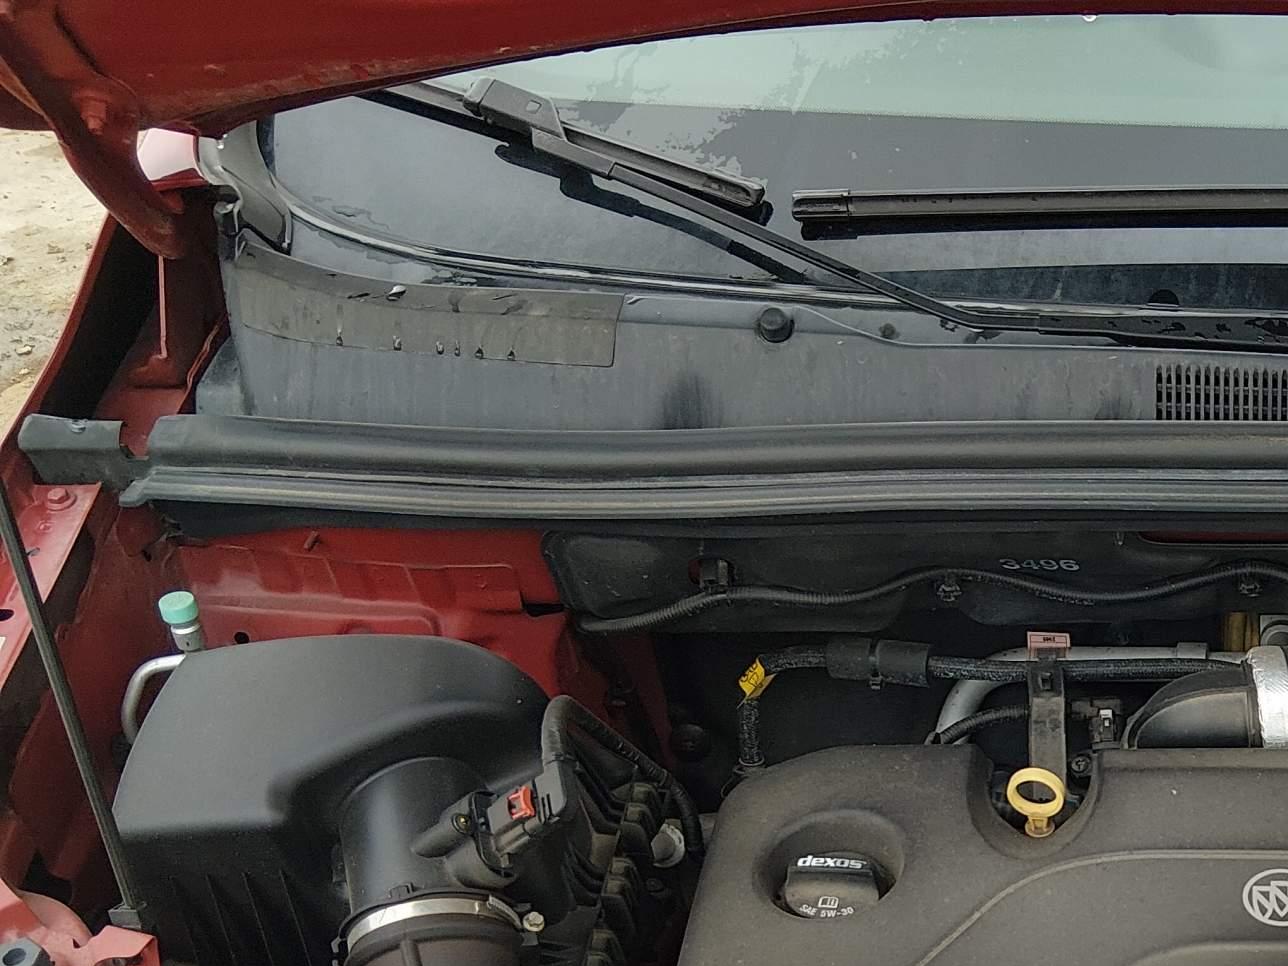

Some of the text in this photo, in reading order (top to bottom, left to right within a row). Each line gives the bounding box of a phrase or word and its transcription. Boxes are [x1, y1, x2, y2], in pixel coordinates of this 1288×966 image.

[999, 558, 1080, 571] 3496
[797, 854, 867, 869] dexos
[800, 904, 854, 917] SAE 5W-30
